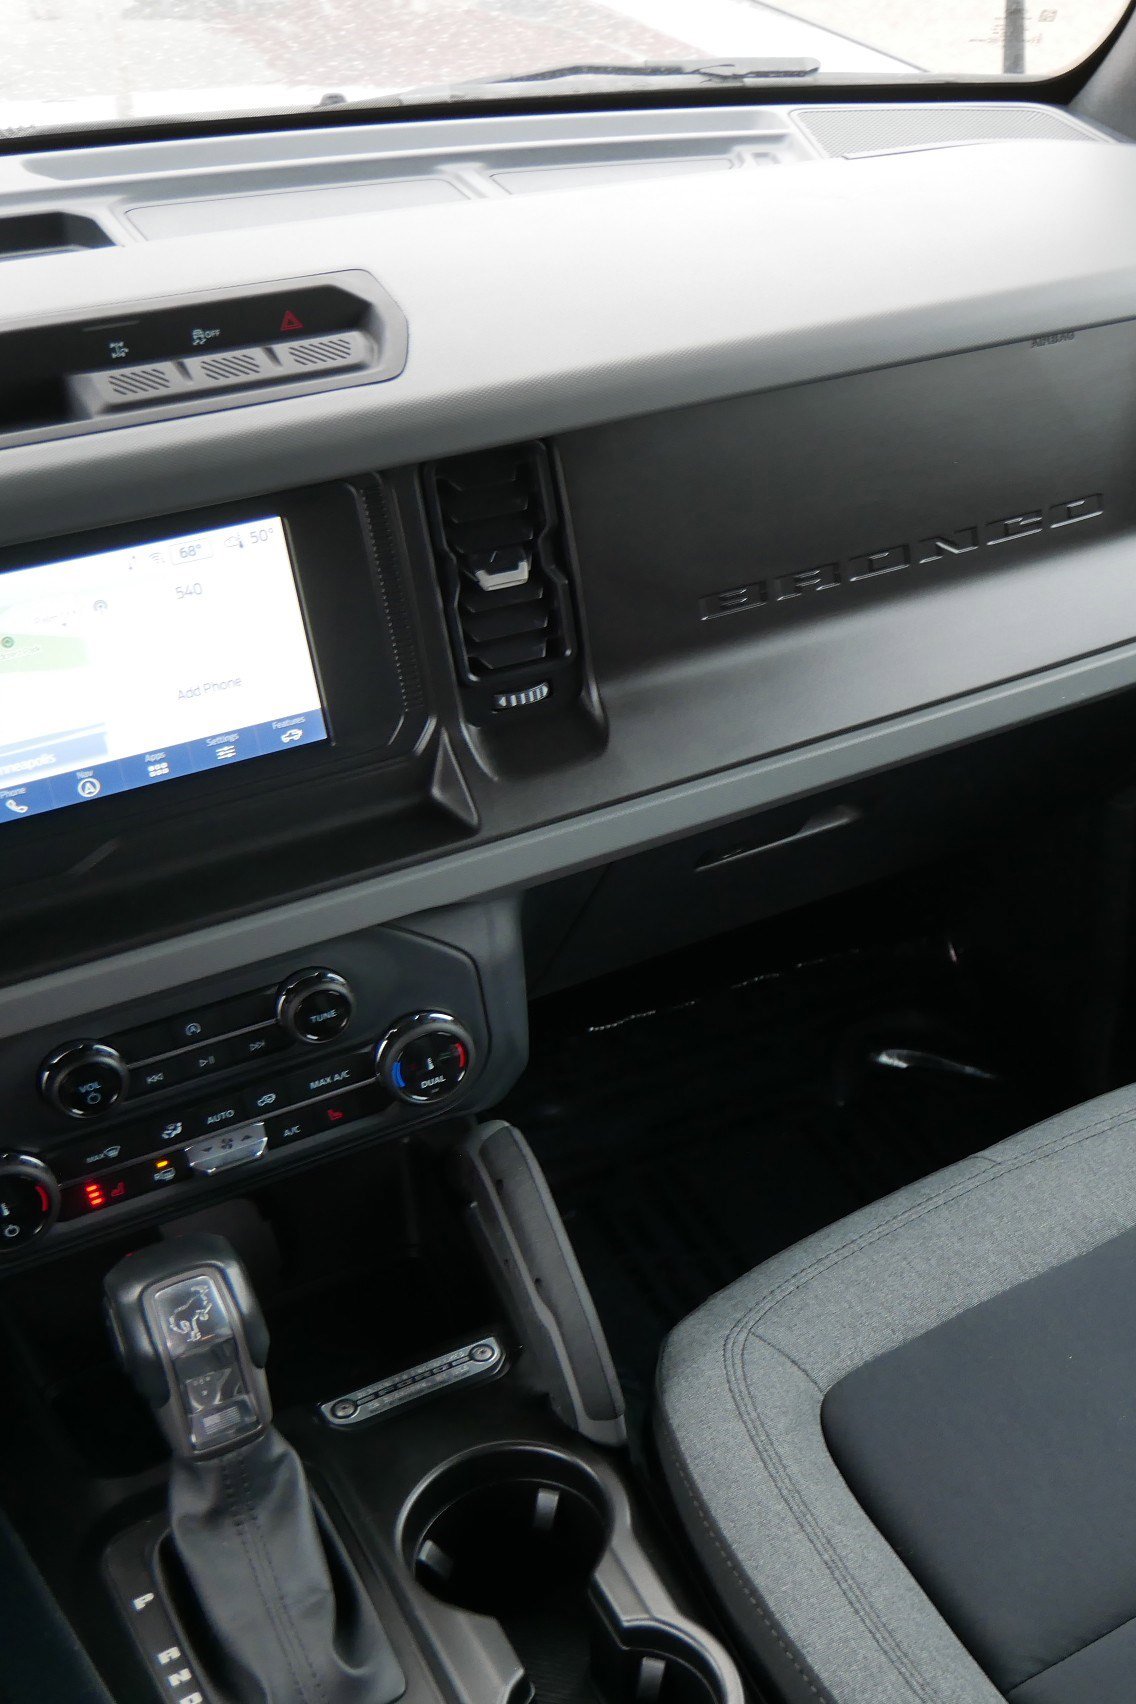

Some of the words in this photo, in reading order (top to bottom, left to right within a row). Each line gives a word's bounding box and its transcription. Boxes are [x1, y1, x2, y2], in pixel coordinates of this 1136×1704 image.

[697, 491, 1106, 622] BRONCO
[177, 685, 201, 701] Add
[203, 676, 242, 696] Phone
[272, 716, 306, 730] Features
[206, 732, 240, 747] Settings
[144, 751, 166, 763] Apps
[310, 1009, 338, 1024] TUNE
[78, 1081, 102, 1093] VOL
[309, 1075, 333, 1090] MAX
[333, 1069, 351, 1082] A/C
[420, 1075, 447, 1089] DUAL
[206, 1109, 235, 1125] AUTO
[283, 1125, 301, 1137] A/C
[133, 1592, 155, 1610] P
[157, 1646, 182, 1665] R
[168, 1668, 192, 1687] N
